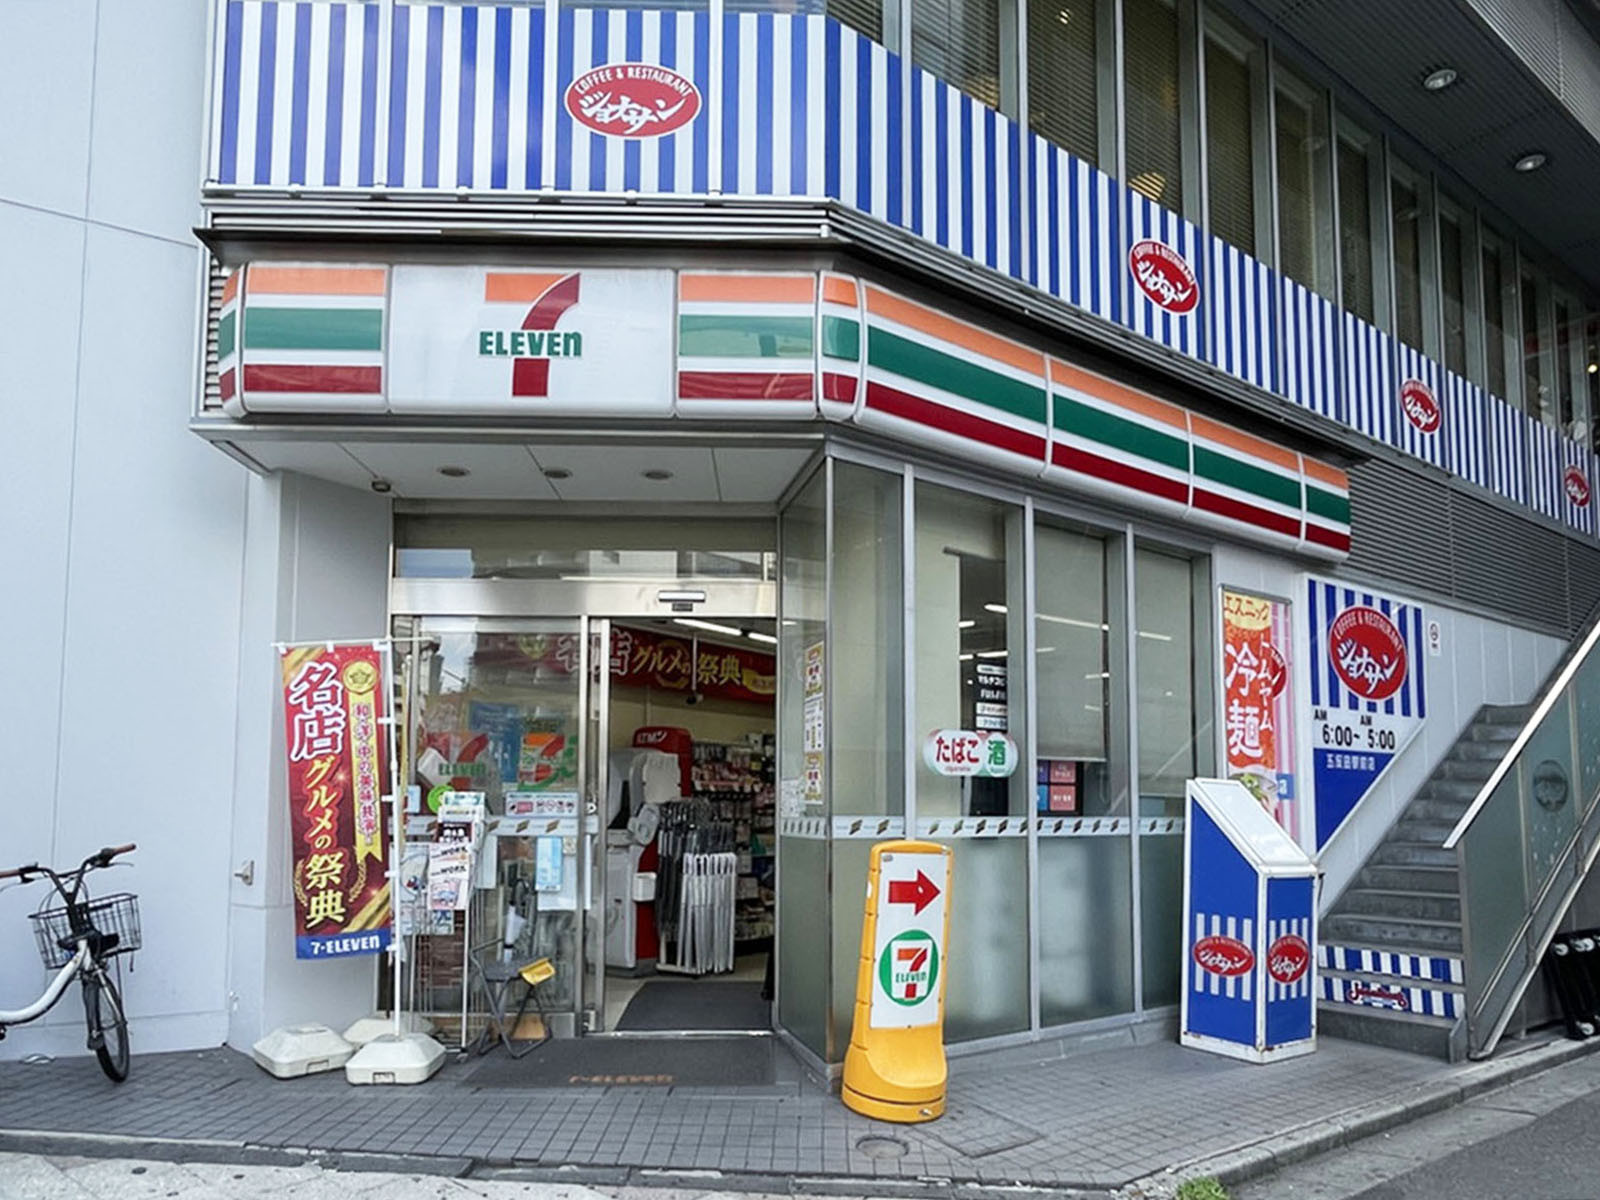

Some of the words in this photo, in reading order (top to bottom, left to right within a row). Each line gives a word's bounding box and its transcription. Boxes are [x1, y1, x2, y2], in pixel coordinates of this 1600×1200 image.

[574, 70, 613, 95] COFFEE
[615, 67, 625, 80] &
[627, 66, 694, 98] RESTAURANT
[485, 272, 580, 397] 7
[1225, 642, 1263, 758] 冷麺
[1314, 709, 1328, 721] AM
[1360, 715, 1373, 726] AM
[936, 736, 980, 764] たばこ
[988, 740, 1006, 766] 酒
[1367, 730, 1396, 750] 5:00
